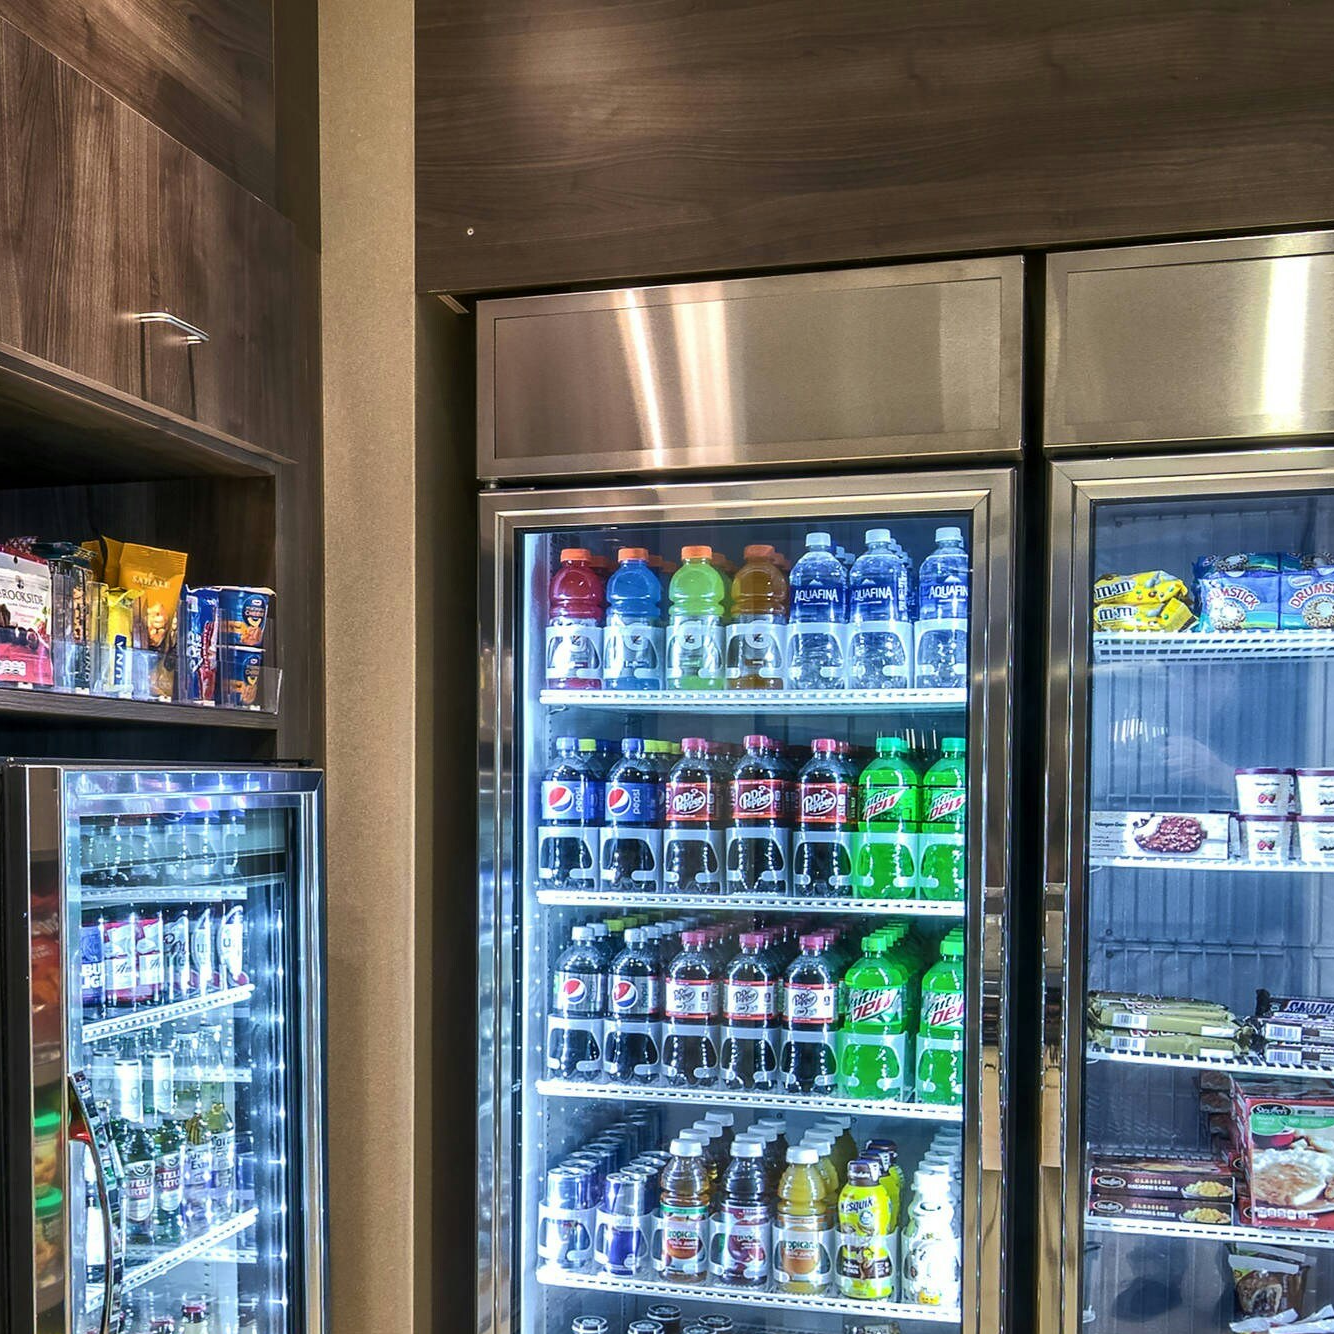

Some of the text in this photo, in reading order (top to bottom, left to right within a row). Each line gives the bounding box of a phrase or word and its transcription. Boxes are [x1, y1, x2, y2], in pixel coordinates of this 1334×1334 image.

[132, 575, 172, 589] SAHALE
[793, 588, 839, 604] AQUAFINA
[850, 586, 894, 602] AQUAFINA
[575, 786, 585, 814] pepsi
[631, 787, 641, 815] pepsi
[675, 794, 704, 813] Pepper
[740, 792, 773, 811] Pepper
[803, 797, 835, 816] Pepper
